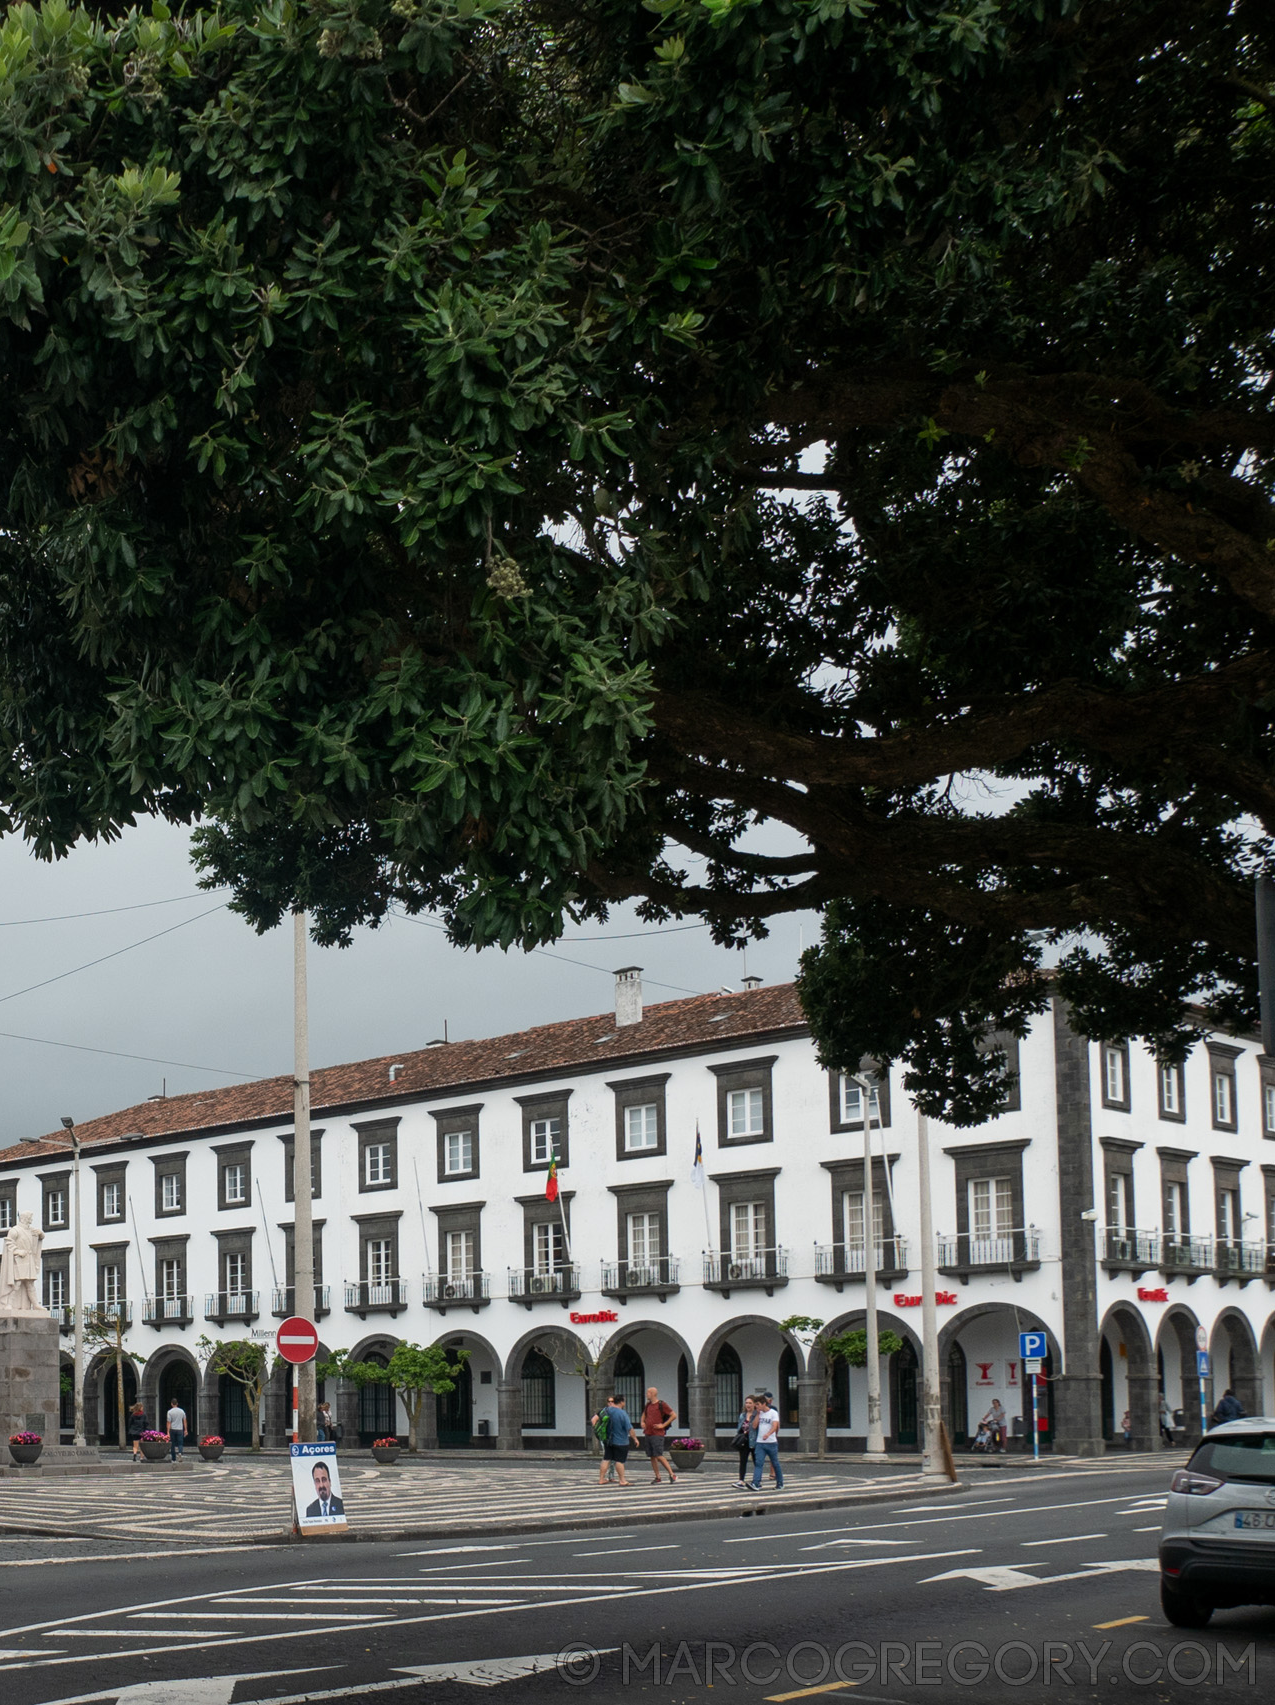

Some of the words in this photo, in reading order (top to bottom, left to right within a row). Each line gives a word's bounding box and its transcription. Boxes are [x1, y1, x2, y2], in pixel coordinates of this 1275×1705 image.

[893, 1291, 958, 1308] EurBic
[570, 1310, 618, 1324] EuroBic
[251, 1328, 278, 1338] Millenn
[1025, 1335, 1041, 1356] P
[302, 1444, 335, 1456] Açores
